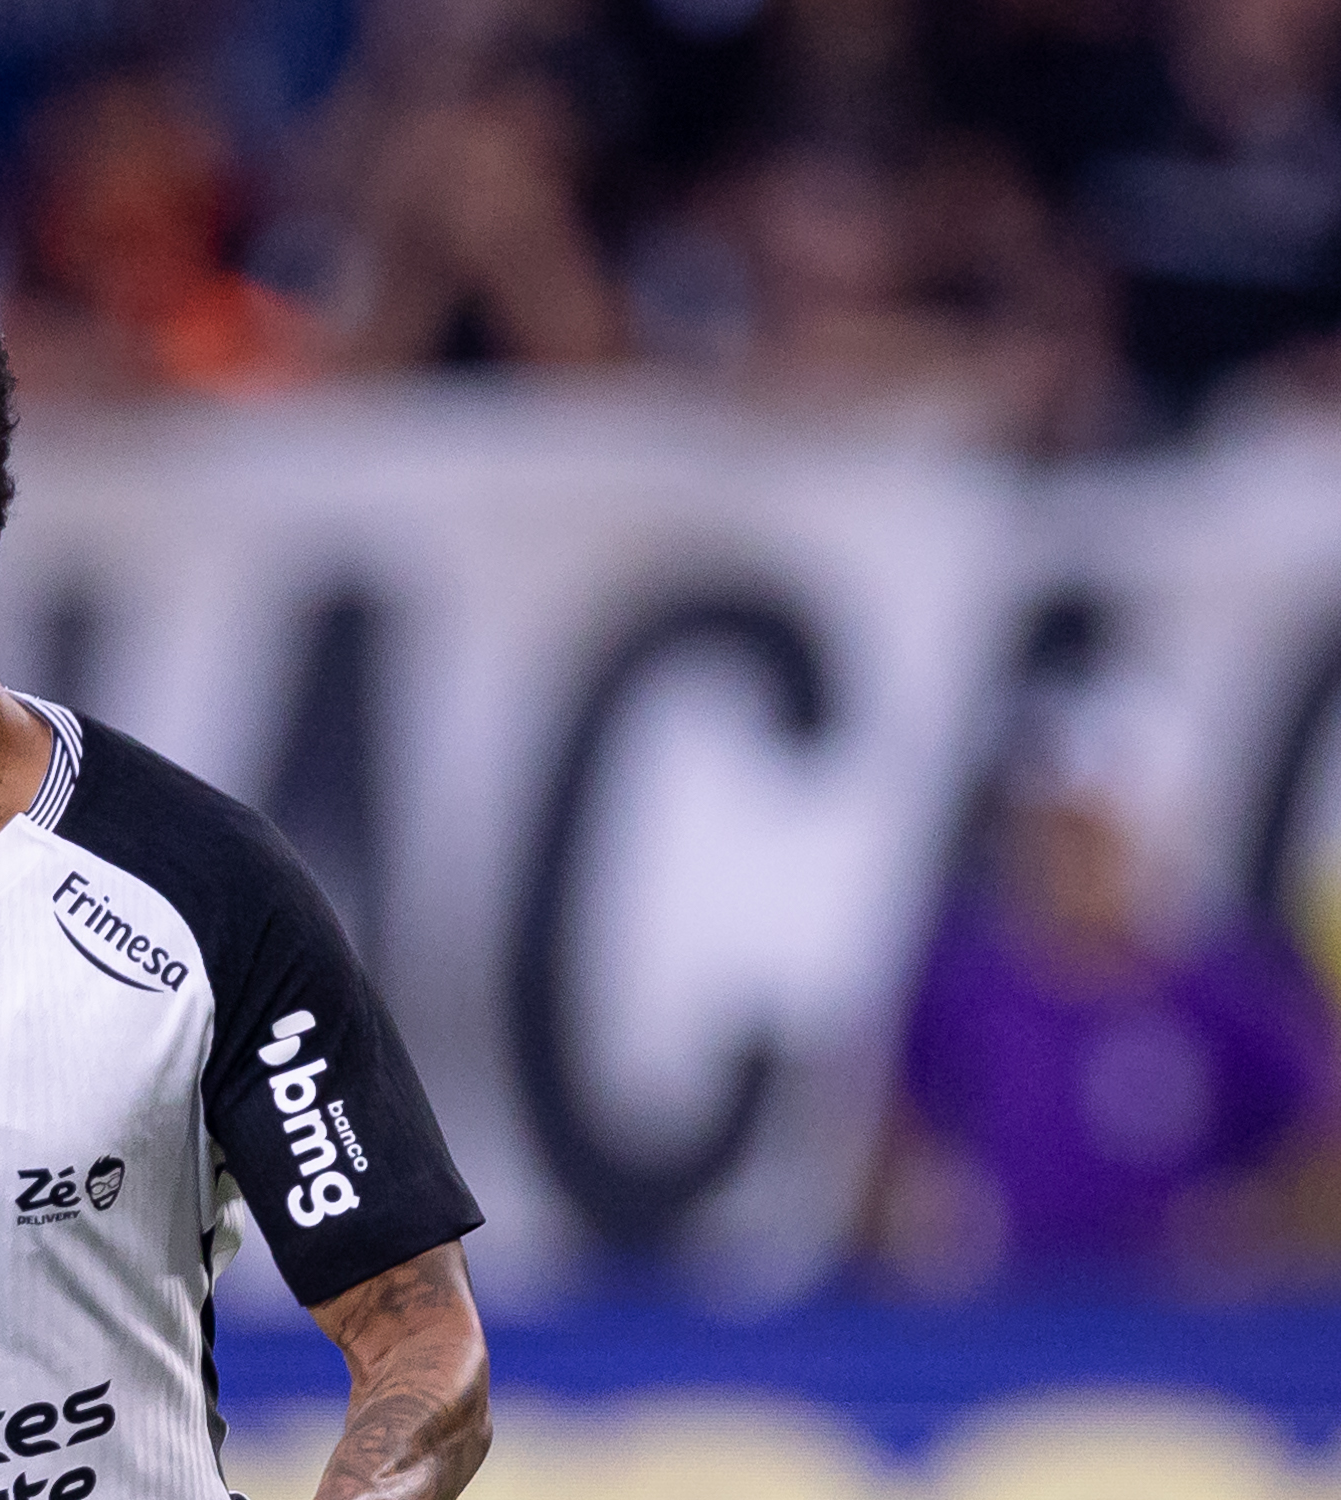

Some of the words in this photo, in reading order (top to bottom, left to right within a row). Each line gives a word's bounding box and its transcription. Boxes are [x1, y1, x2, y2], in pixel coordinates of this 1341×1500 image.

[52, 870, 190, 993] Frimesa
[268, 1057, 361, 1228] bmg
[327, 1099, 369, 1172] banco
[15, 1165, 82, 1212] Zé
[17, 1209, 81, 1226] DELIVERY
